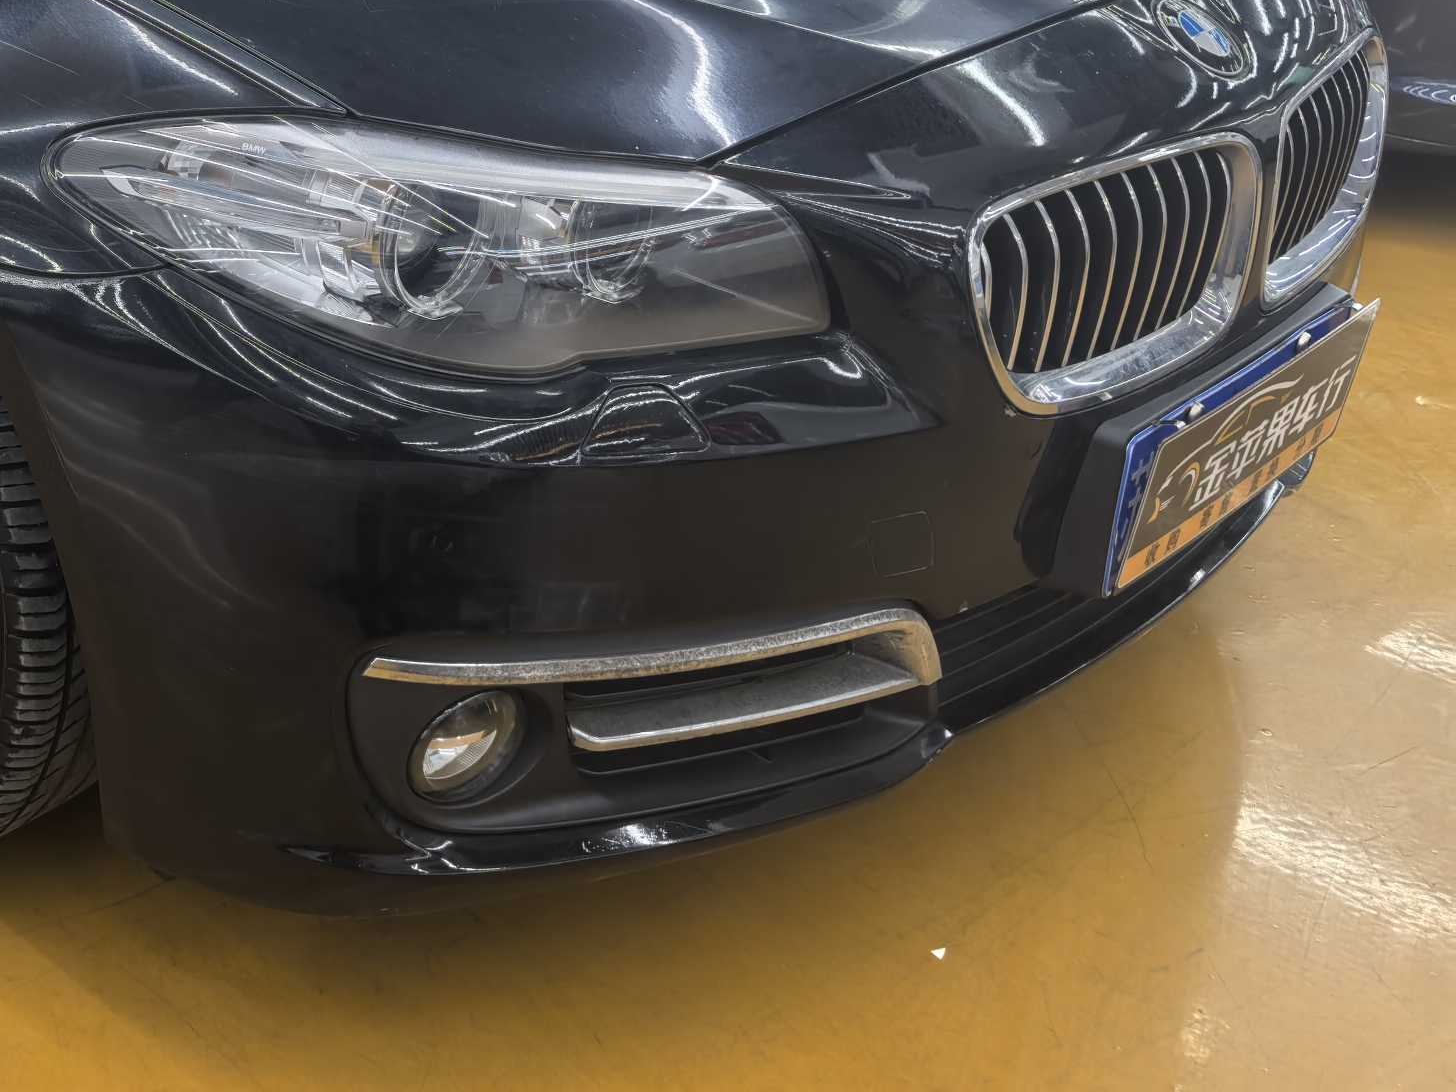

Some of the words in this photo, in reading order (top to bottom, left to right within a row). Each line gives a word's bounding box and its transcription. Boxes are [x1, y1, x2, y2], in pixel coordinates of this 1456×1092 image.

[1188, 355, 1357, 512] 金苹果车行
